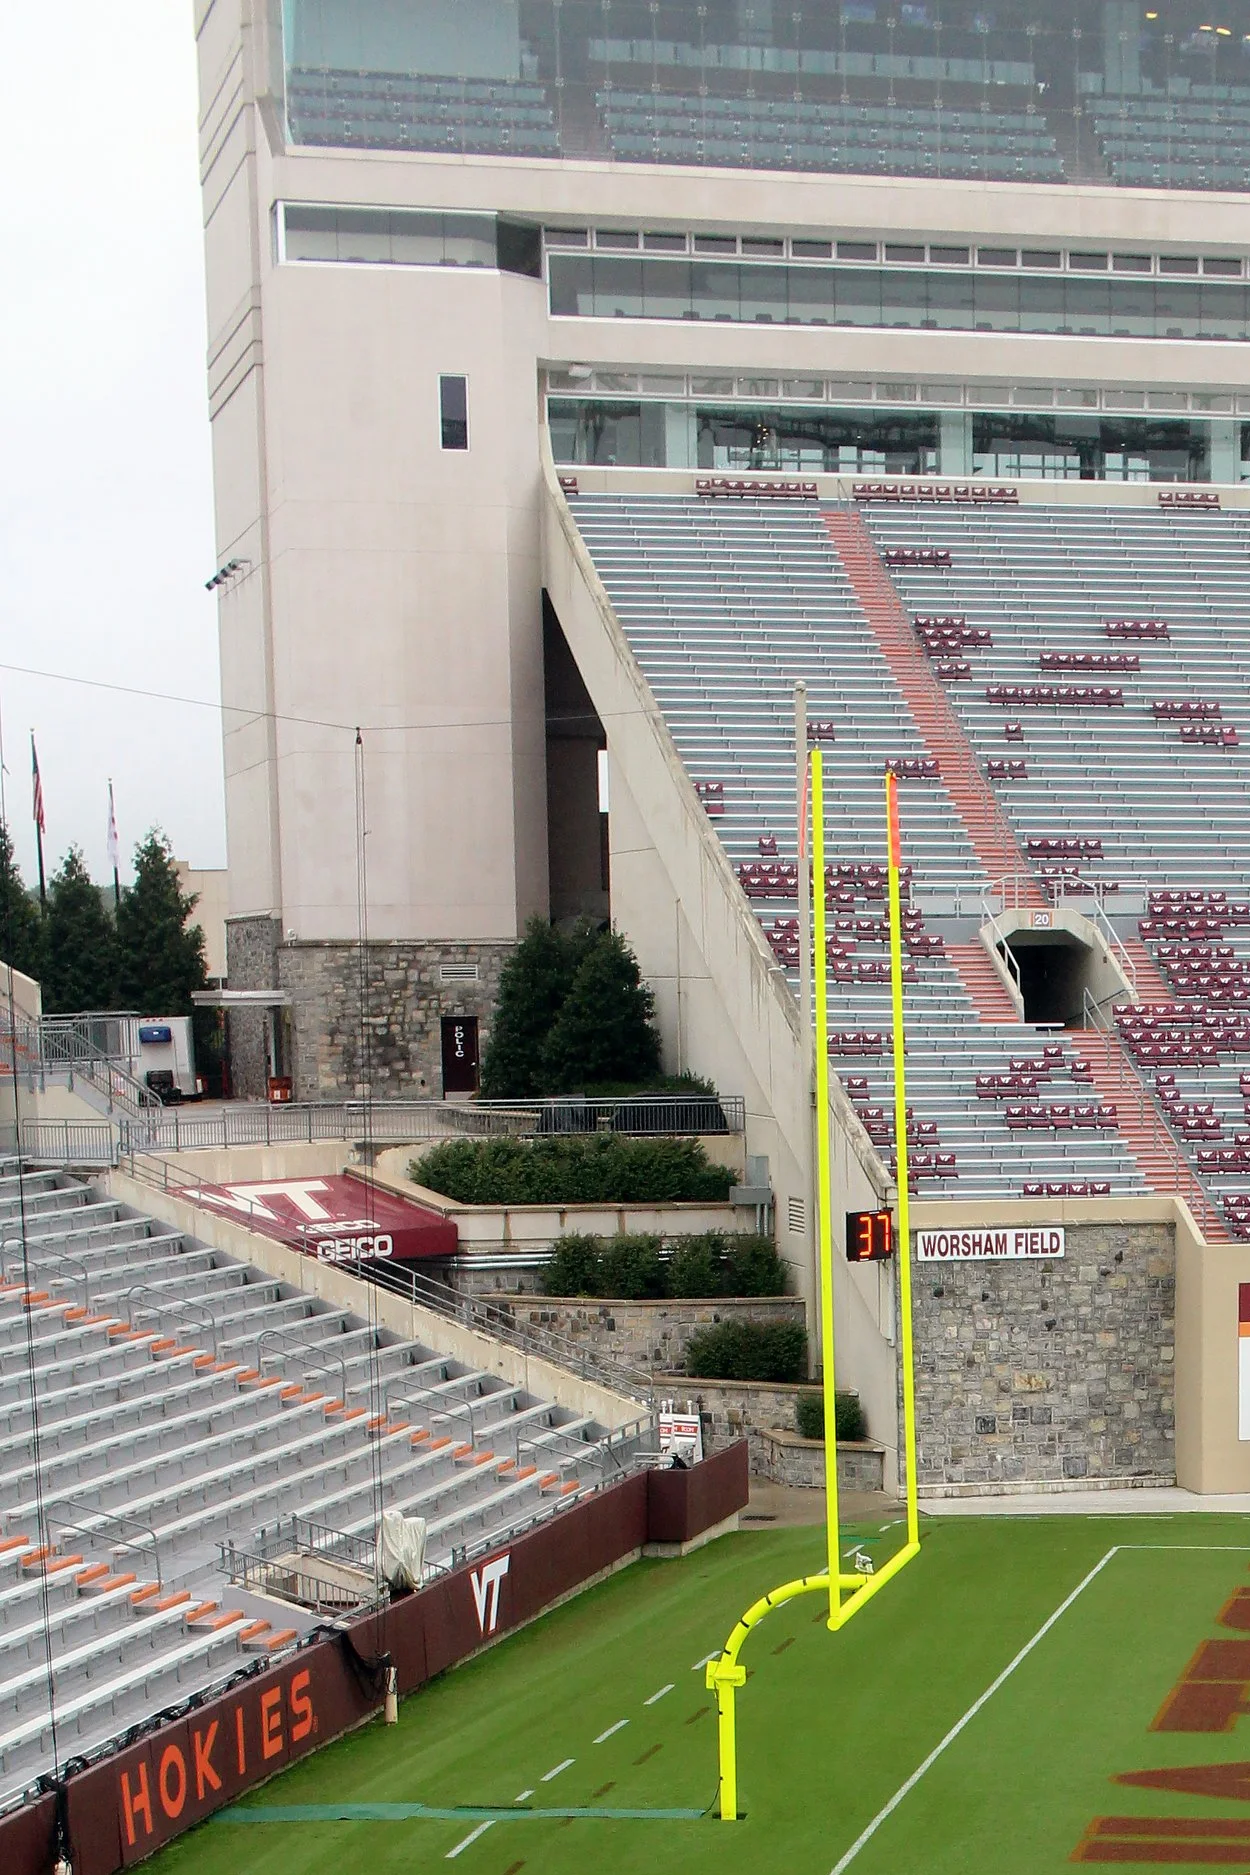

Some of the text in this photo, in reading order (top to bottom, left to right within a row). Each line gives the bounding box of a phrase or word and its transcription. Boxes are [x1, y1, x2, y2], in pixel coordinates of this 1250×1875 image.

[1034, 914, 1049, 925] 20
[454, 1025, 465, 1058] POLIC
[180, 1180, 333, 1221] VT
[295, 1219, 381, 1234] GEICO
[859, 1214, 890, 1256] 37
[316, 1235, 393, 1262] GEICO
[921, 1231, 1060, 1258] WORSHAM FIELD
[470, 1553, 511, 1634] VT
[120, 1667, 314, 1846] HOKIES
